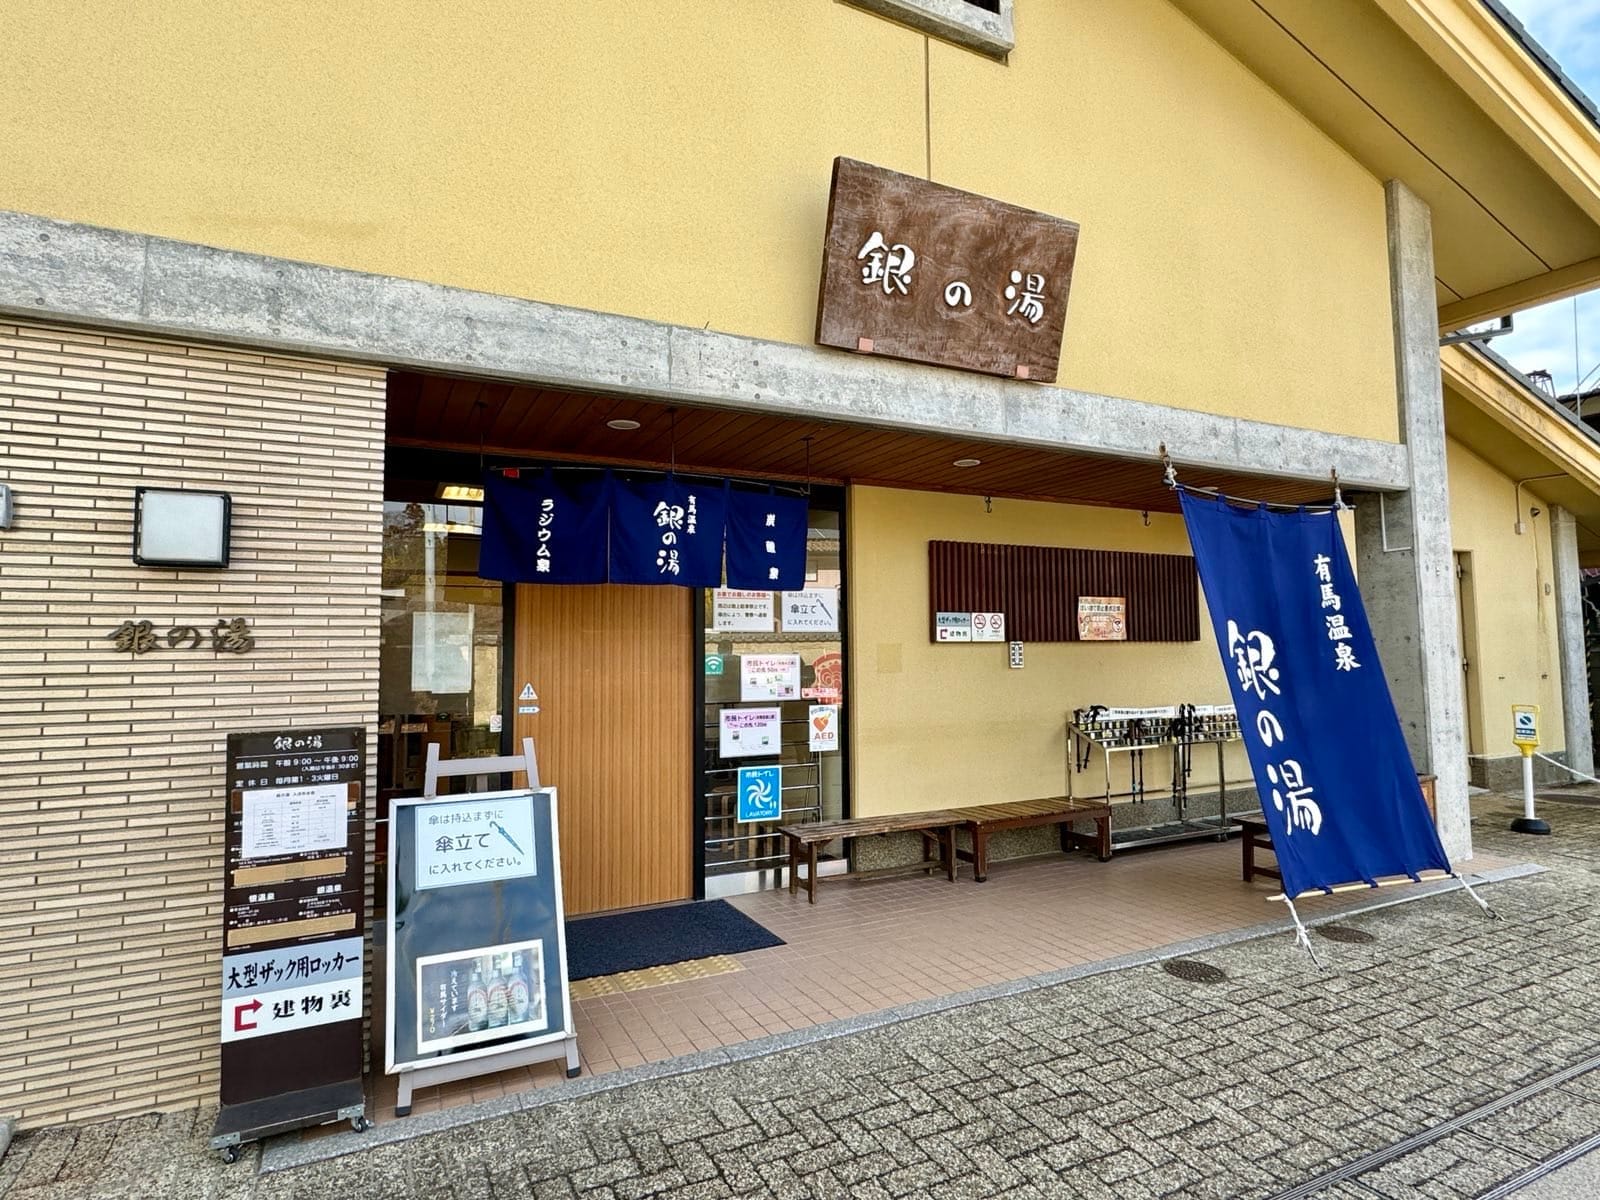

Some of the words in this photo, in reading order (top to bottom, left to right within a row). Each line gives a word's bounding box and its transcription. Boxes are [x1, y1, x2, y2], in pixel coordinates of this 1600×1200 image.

[857, 231, 1045, 324] 銀の湯
[536, 498, 554, 573] ラジウム泉
[653, 501, 685, 576] 銀の湯
[1313, 553, 1361, 672] 有馬温泉
[107, 617, 255, 655] 銀の湯
[273, 735, 322, 750] 銀の湯
[814, 731, 834, 740] AED
[1227, 620, 1323, 836] 銀の湯
[428, 809, 504, 825] 傘は持込まずに
[435, 832, 491, 853] 傘立て
[429, 857, 521, 875] に入れてください。
[226, 951, 360, 991] 大型ザック用ロッカー
[272, 989, 352, 1020] 建物裏
